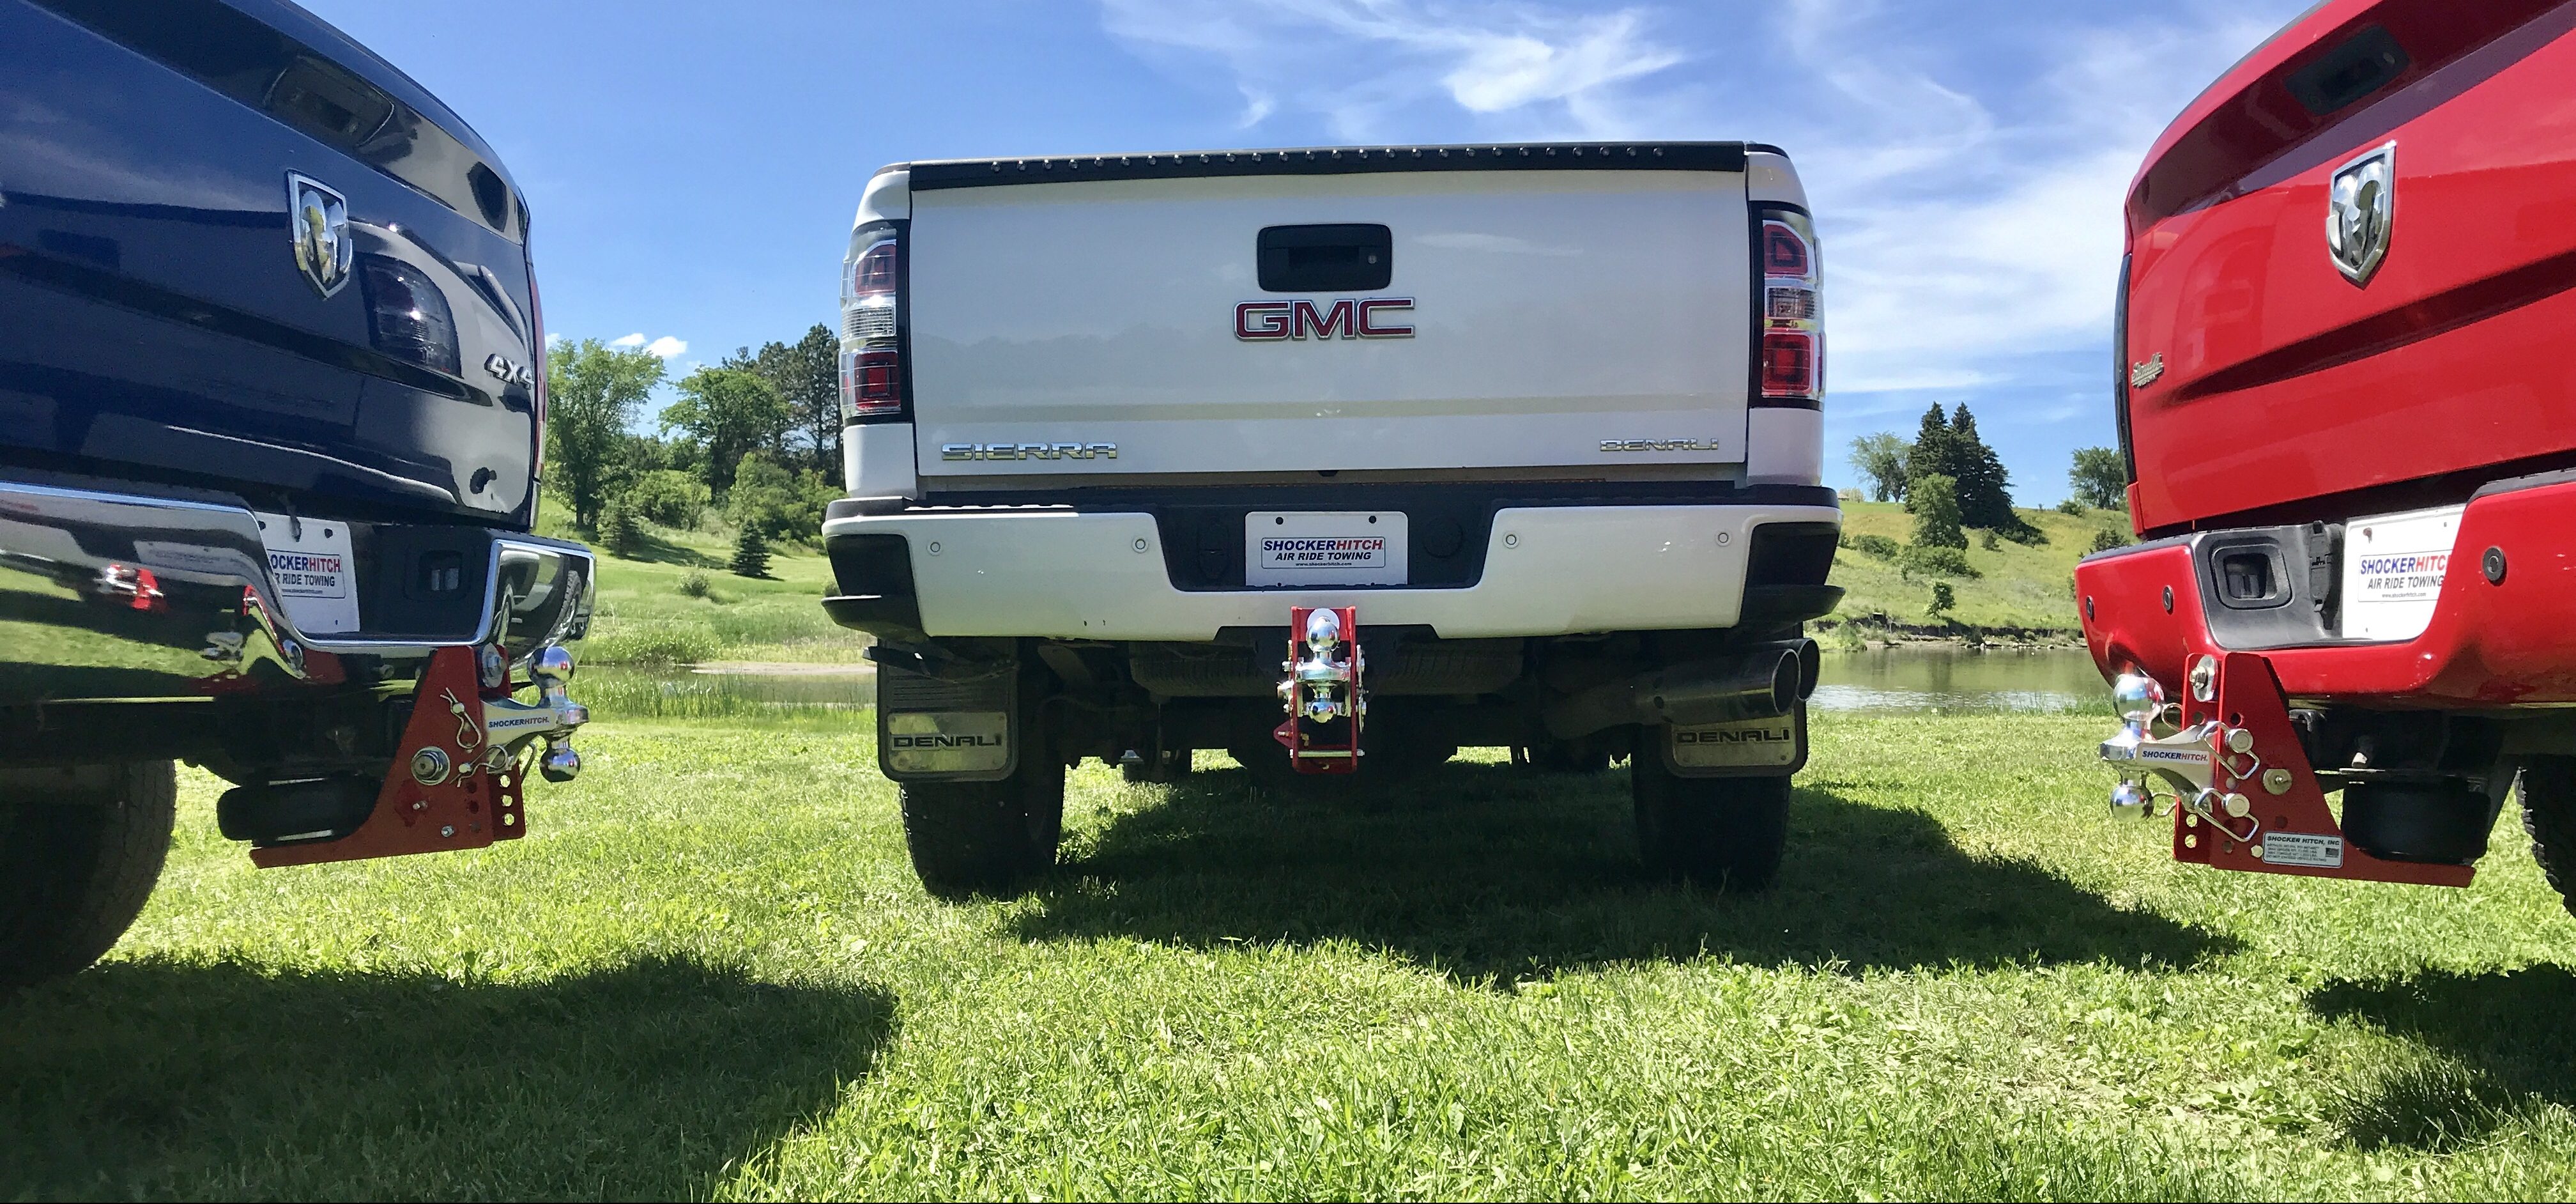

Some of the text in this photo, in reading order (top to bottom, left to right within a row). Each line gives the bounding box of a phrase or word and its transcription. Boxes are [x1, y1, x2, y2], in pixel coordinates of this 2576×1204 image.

[1234, 297, 1415, 341] GMC
[942, 442, 1117, 461] SIERRA
[1600, 438, 1718, 451] DENALI
[1264, 539, 1384, 551] SHOCKERHITCH
[1275, 552, 1372, 560] AIR RIDE TOWING
[282, 573, 302, 585] RIDE
[305, 574, 335, 587] TOWING
[2367, 575, 2444, 589] AIR RIDE TOWING
[894, 736, 1002, 748] DENALI
[1676, 729, 1790, 743] DENALI
